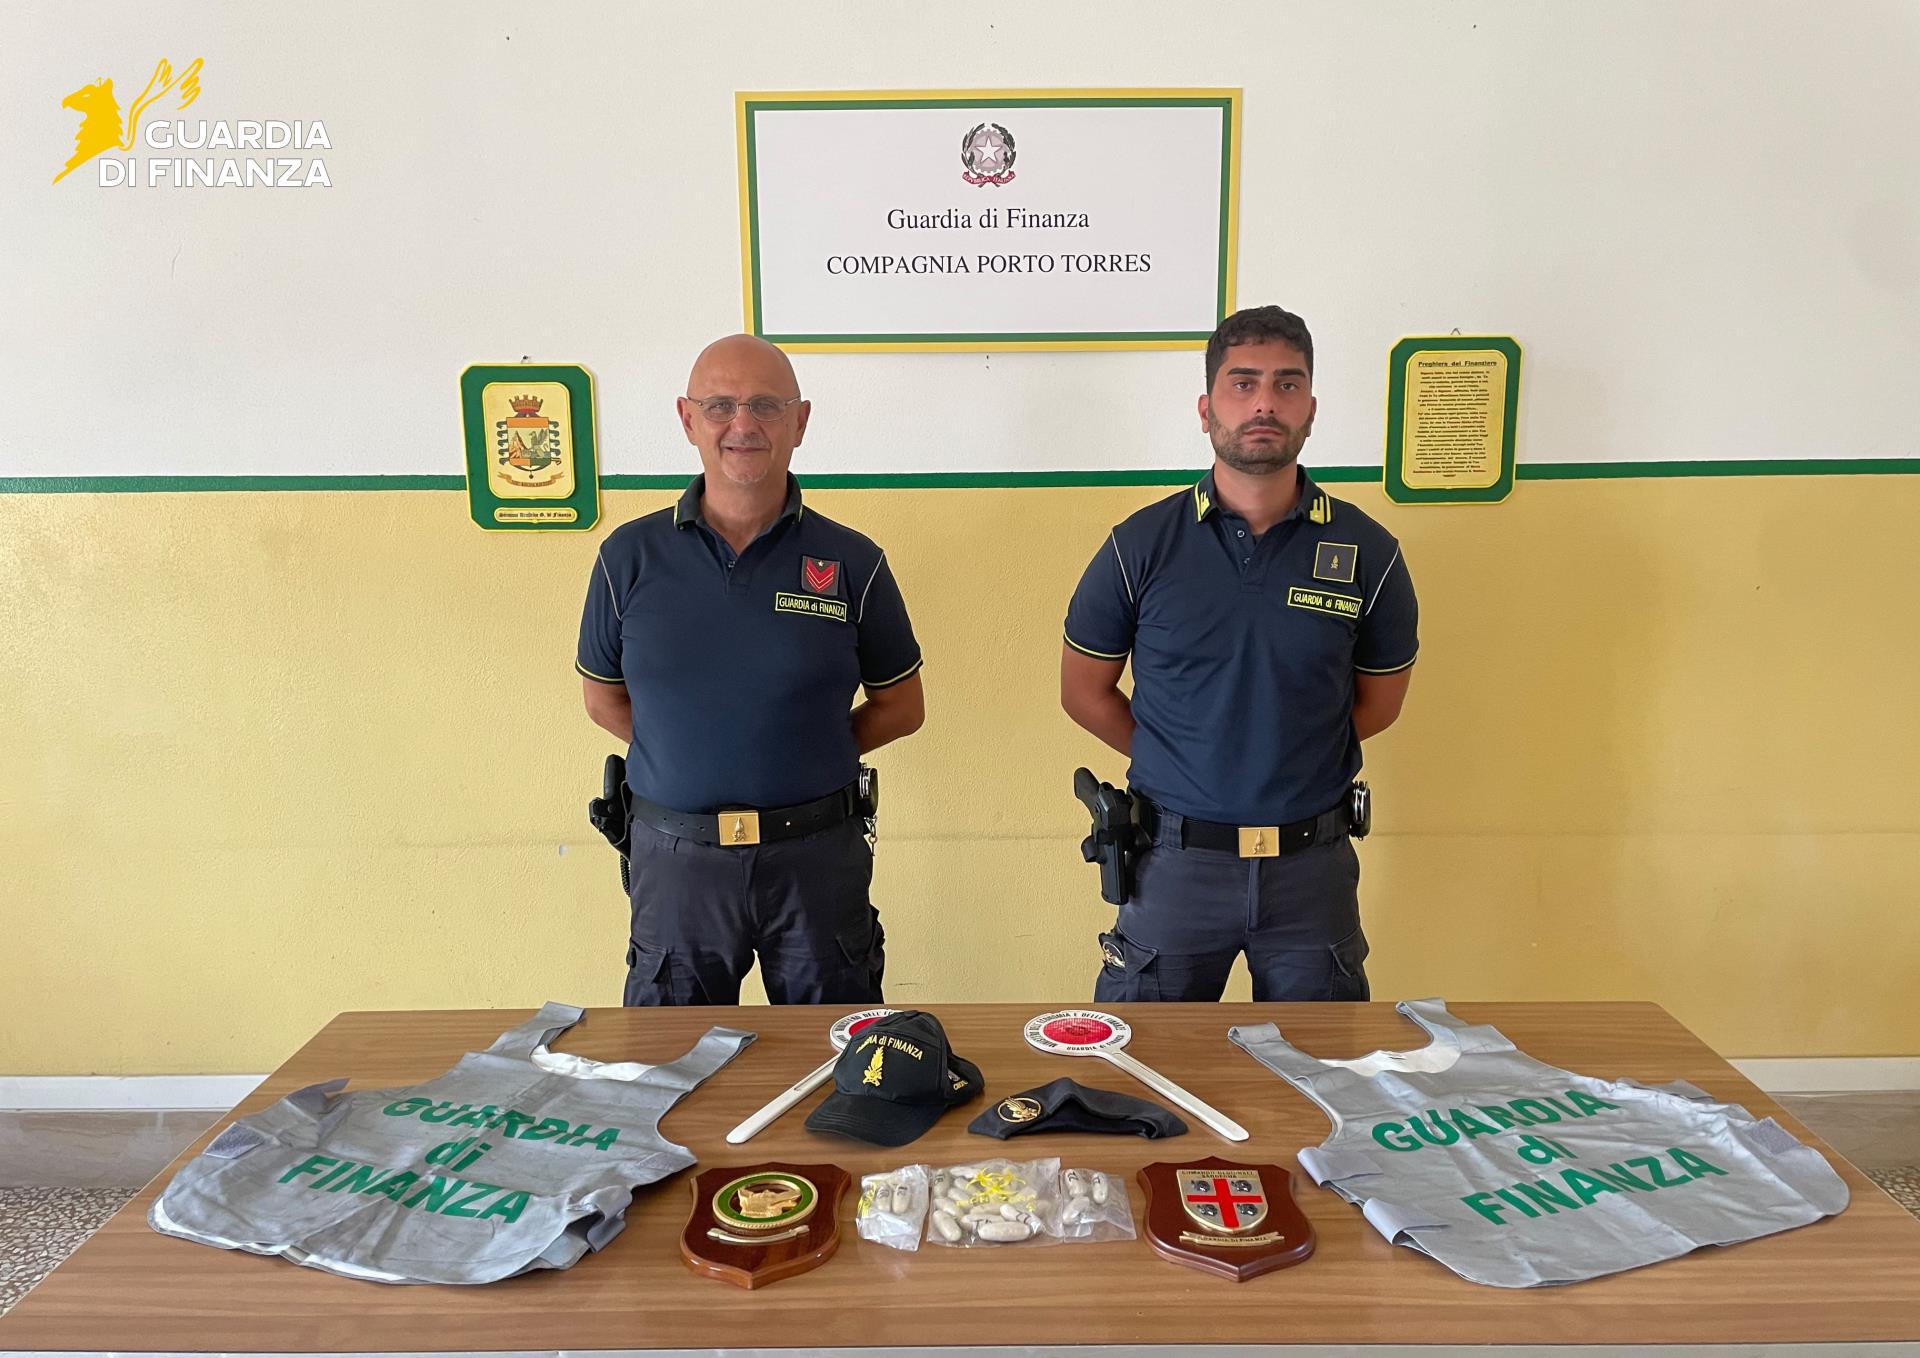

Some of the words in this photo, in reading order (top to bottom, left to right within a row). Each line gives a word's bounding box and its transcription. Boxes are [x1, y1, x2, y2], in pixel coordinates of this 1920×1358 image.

[888, 209, 972, 229] Guardia
[980, 209, 997, 228] di
[1007, 209, 1089, 228] Finanza
[827, 255, 969, 275] COMPAGNIA
[977, 255, 1055, 273] PORTO
[1061, 254, 1151, 273] TORRES
[779, 597, 810, 610] GUARDIA
[810, 602, 818, 612] di
[820, 602, 844, 617] FINANZA
[1294, 593, 1322, 606] GUARDIA
[1325, 599, 1332, 608] di
[1334, 600, 1359, 613] FINANZA
[879, 1035, 886, 1046] di
[887, 1038, 923, 1060] FINANZA
[383, 1097, 621, 1151] GUARDIA
[1371, 1089, 1622, 1153] GUARDIA
[425, 1136, 493, 1173] di
[1517, 1134, 1578, 1165] di
[278, 1154, 531, 1224] FINANZA
[1460, 1147, 1729, 1225] FINANZA
